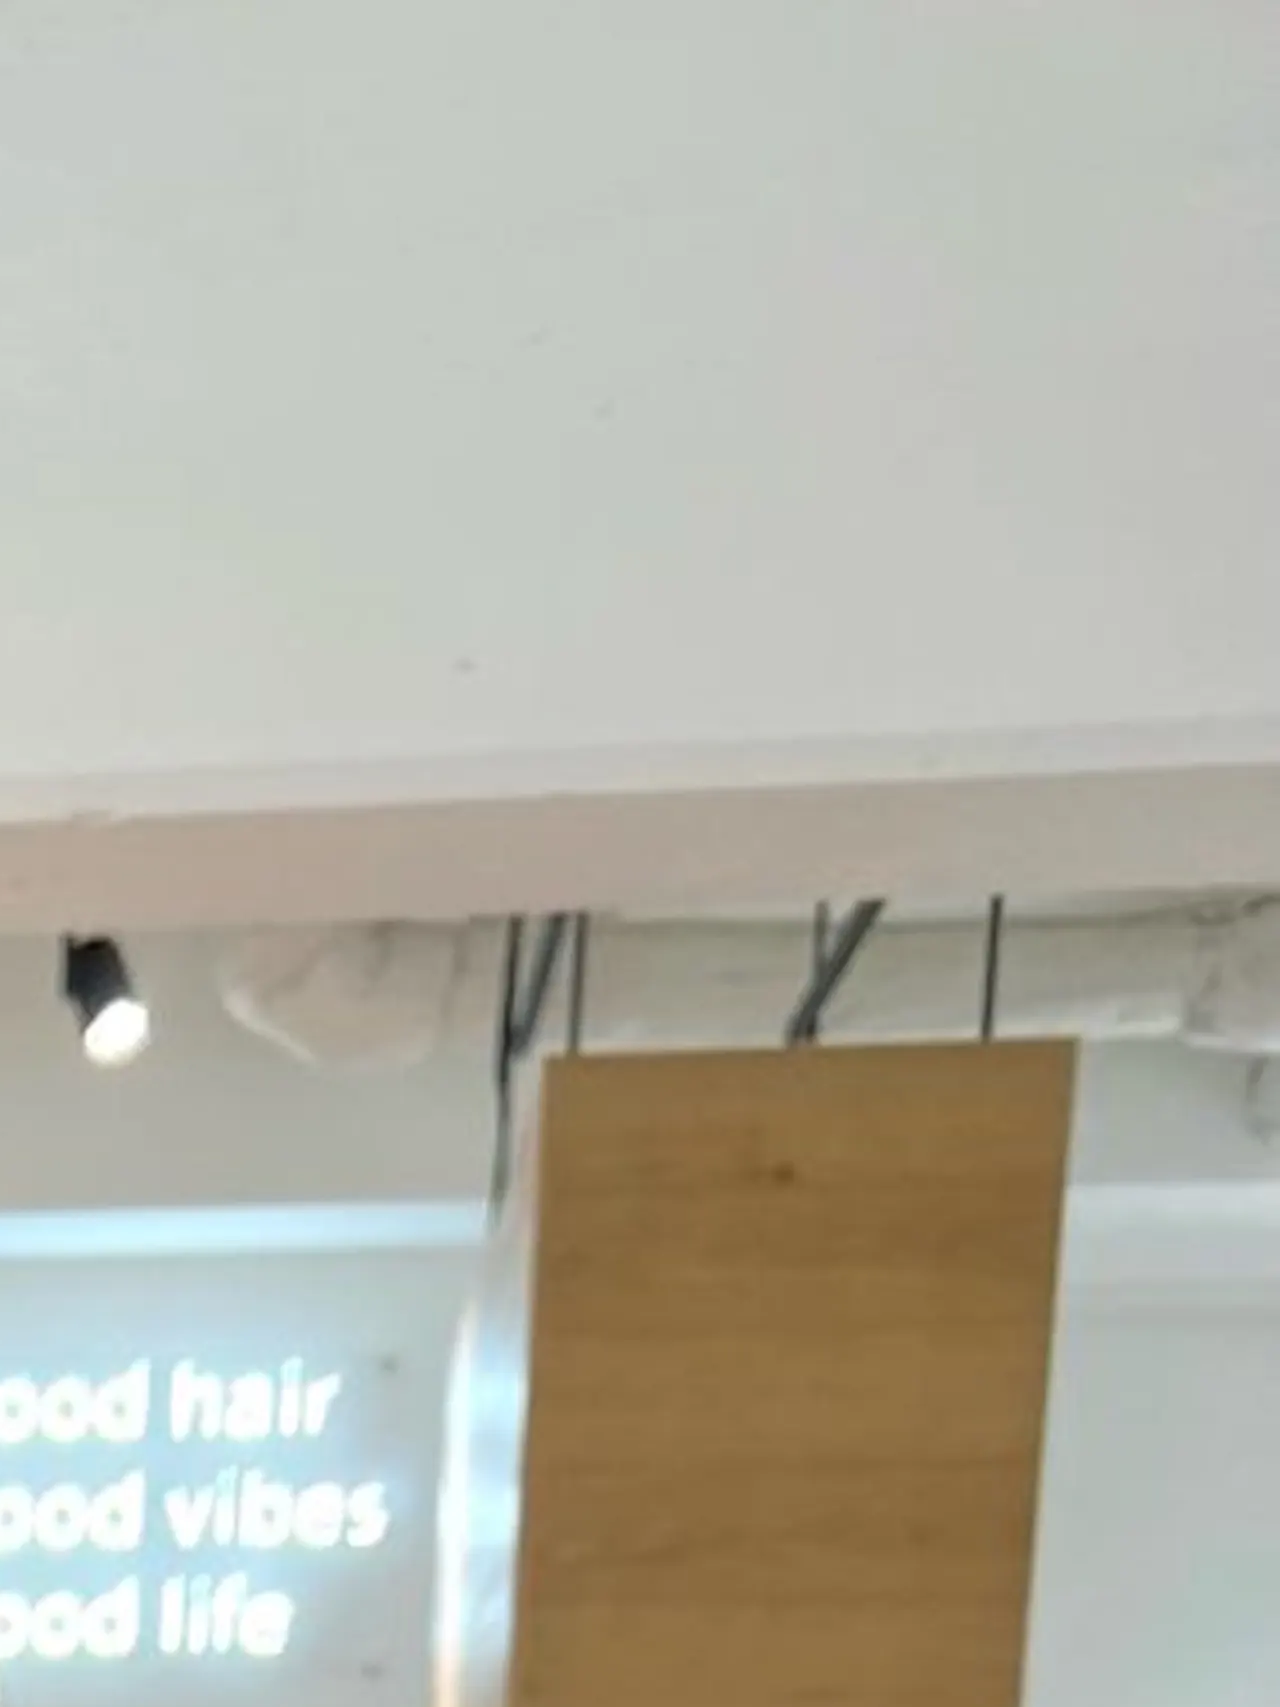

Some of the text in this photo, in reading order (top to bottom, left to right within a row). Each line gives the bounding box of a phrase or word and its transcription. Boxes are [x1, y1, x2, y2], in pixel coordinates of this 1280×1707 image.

[170, 1357, 340, 1441] hair
[165, 1466, 389, 1547] vibes
[158, 1571, 294, 1656] life
